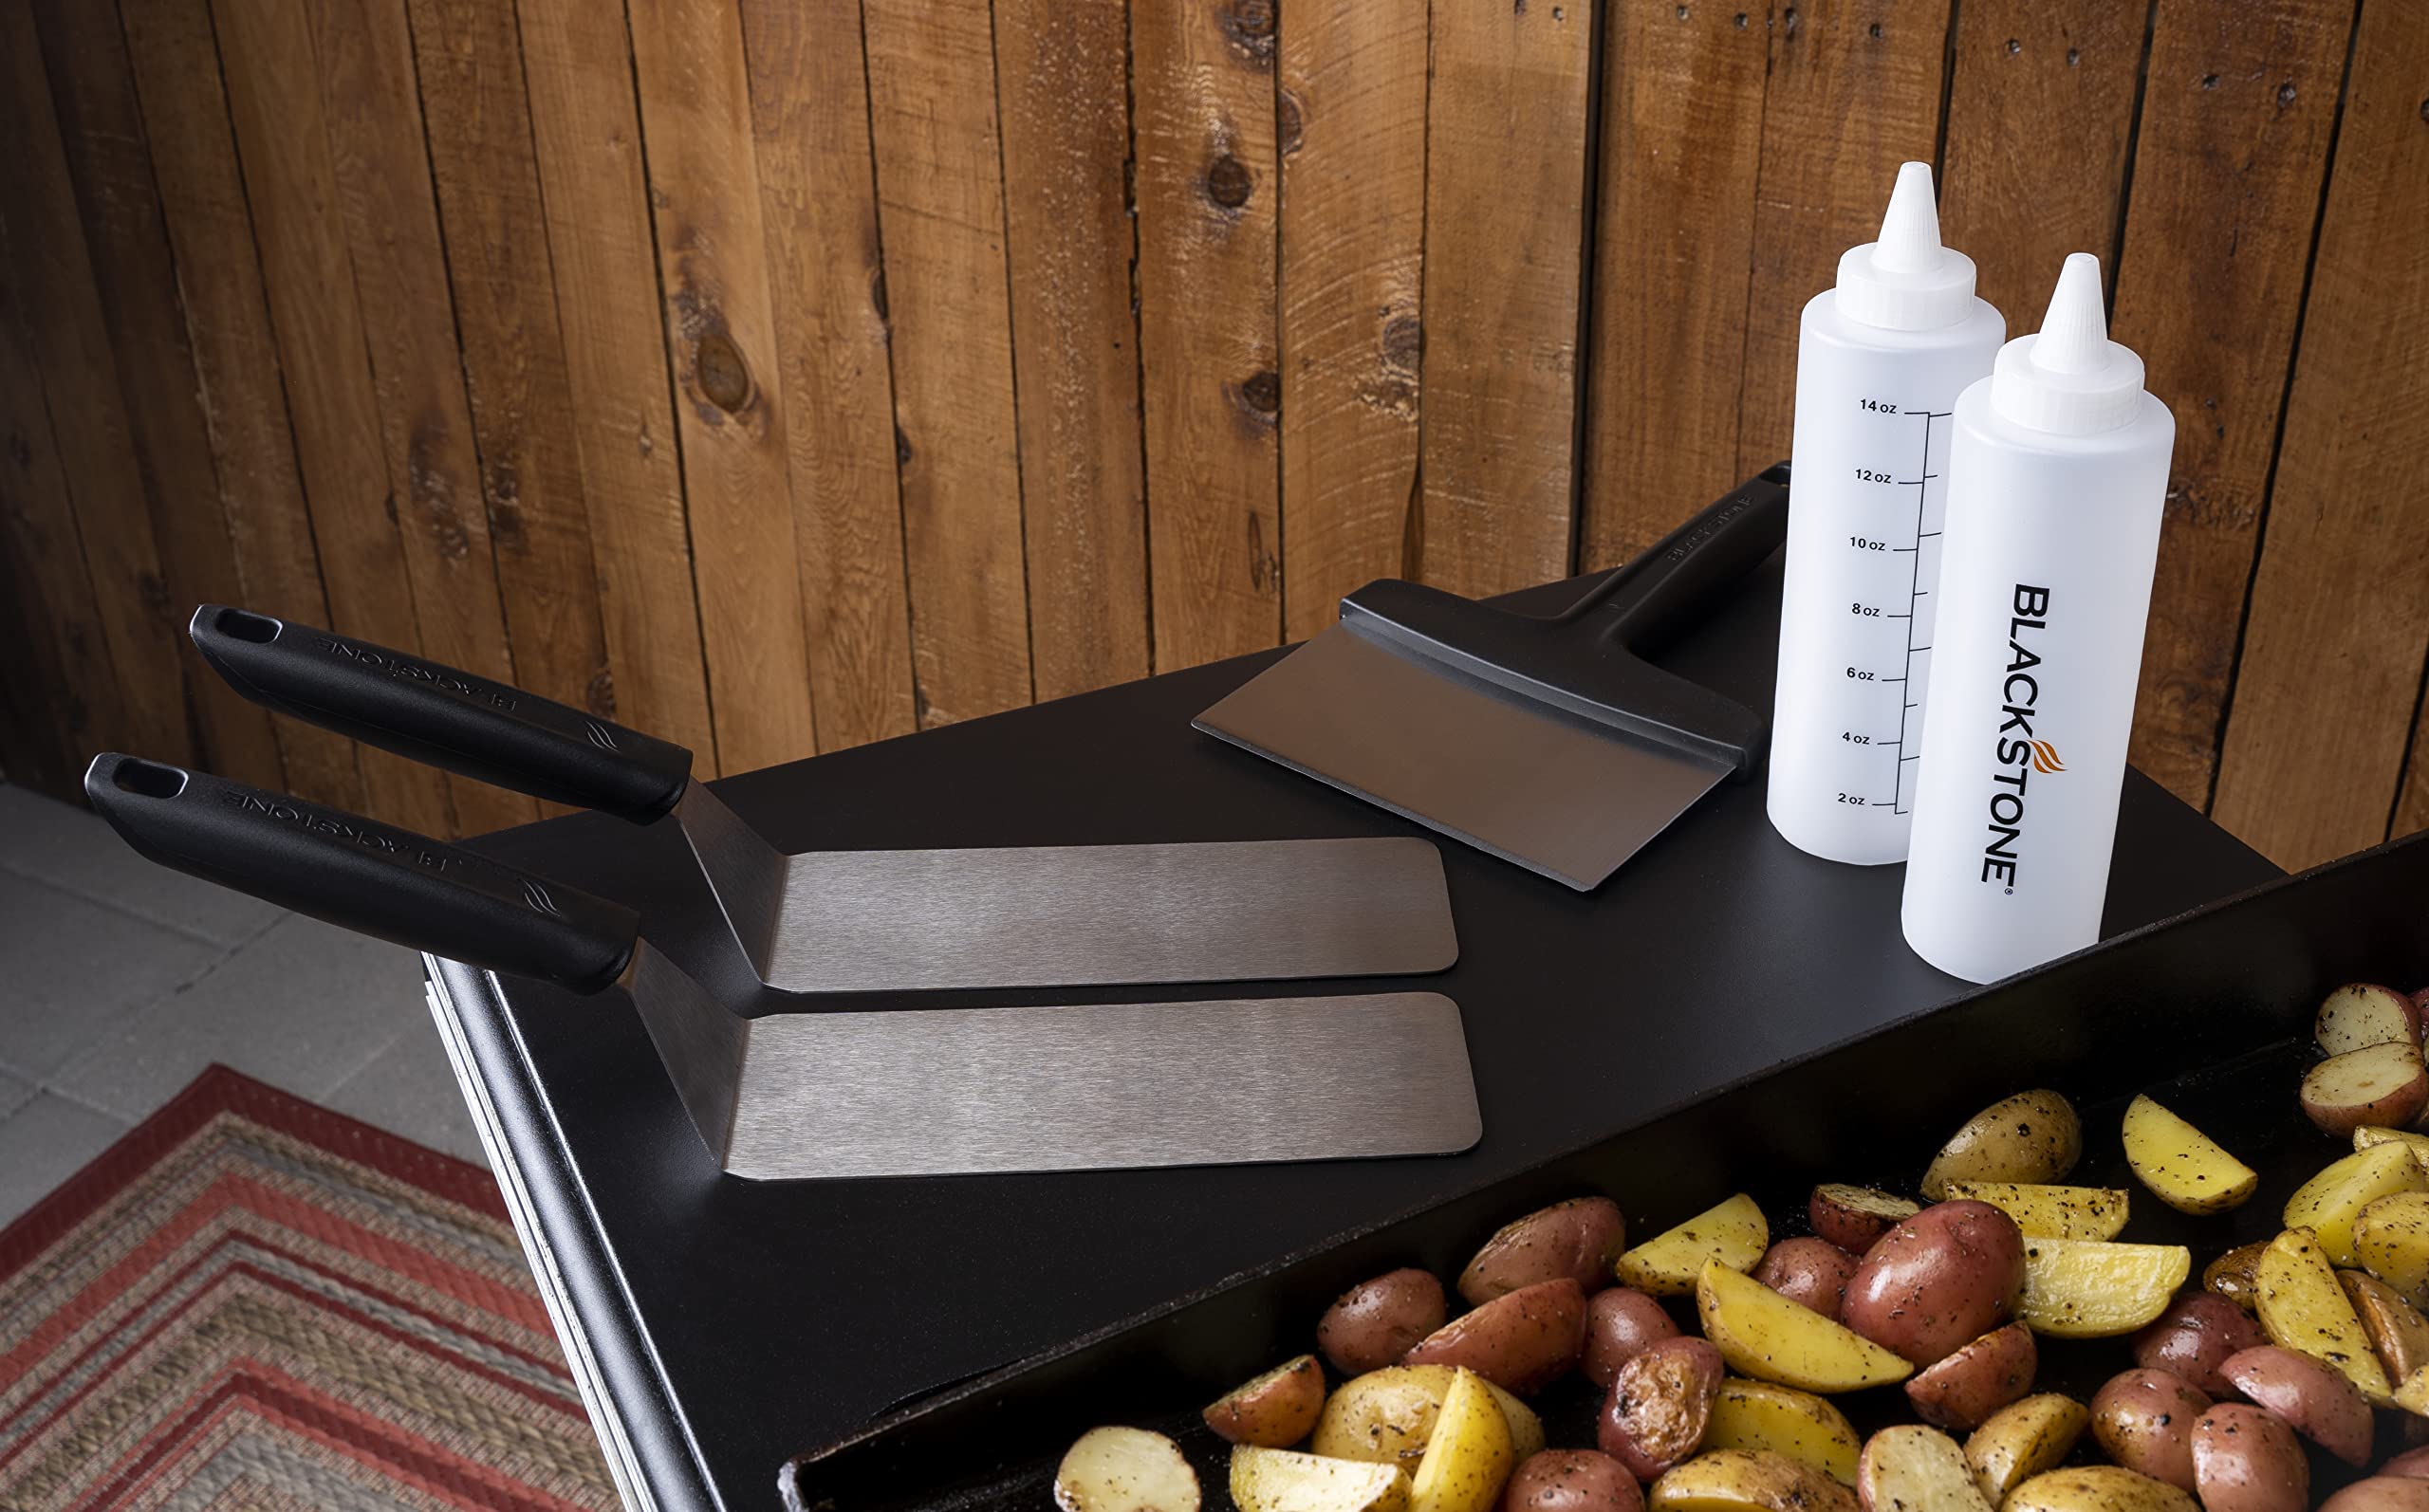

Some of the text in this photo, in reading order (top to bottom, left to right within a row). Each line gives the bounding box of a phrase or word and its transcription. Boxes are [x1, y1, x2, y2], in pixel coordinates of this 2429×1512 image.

[1860, 398, 1898, 415] 14 oz
[1855, 468, 1892, 485] 12 oz
[1849, 536, 1886, 552] 10 oz
[1851, 602, 1881, 618] 8 oz
[1846, 666, 1875, 682] 6 oz
[1842, 731, 1870, 746] 4 oz
[1837, 792, 1865, 806] 2 oz
